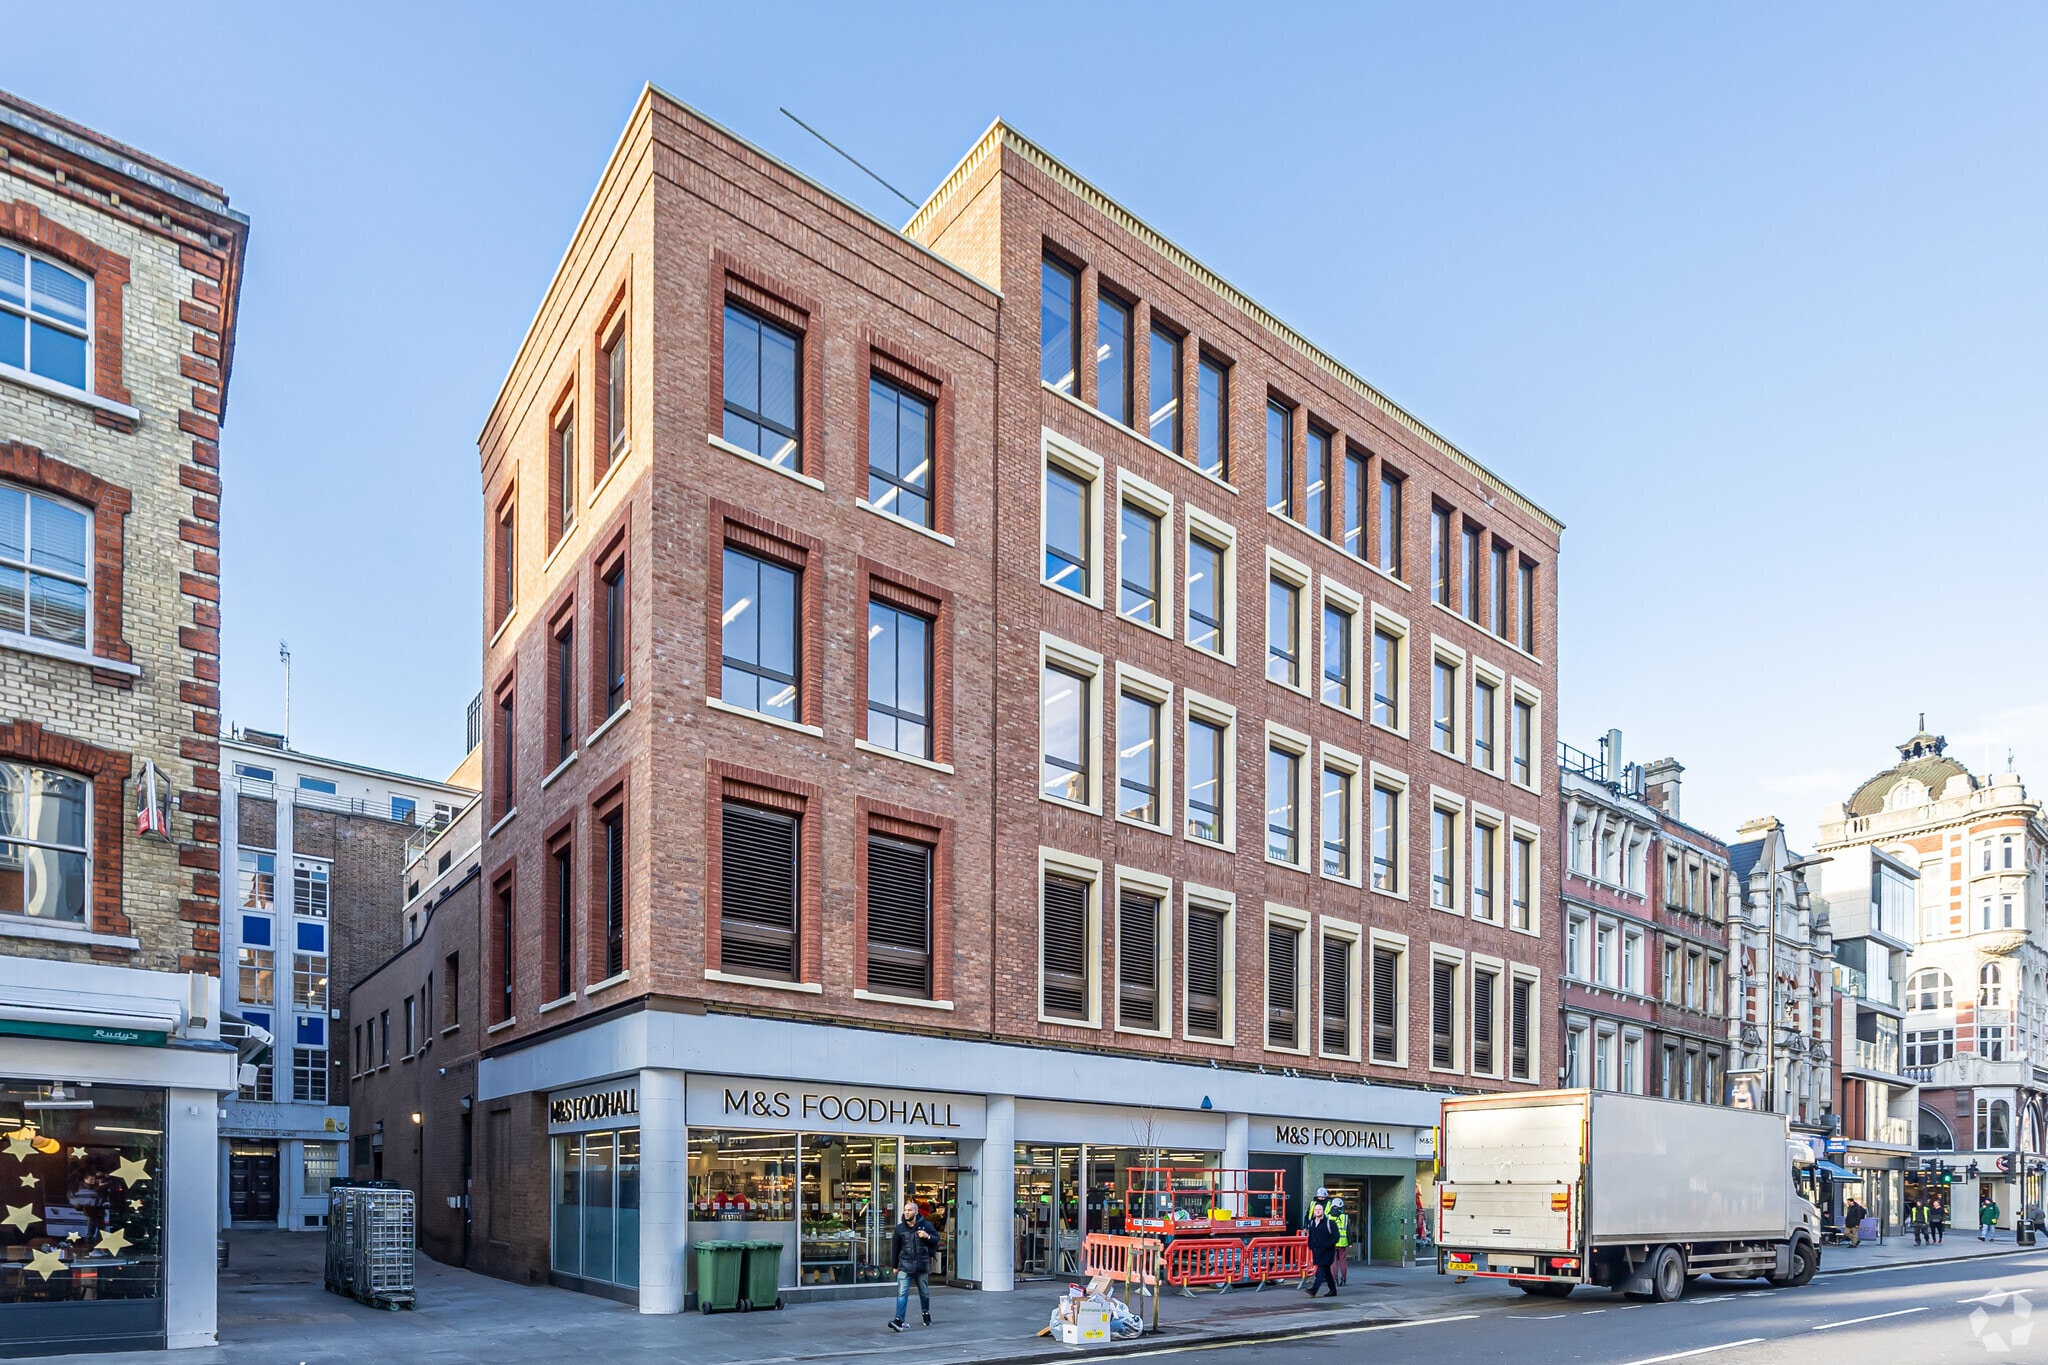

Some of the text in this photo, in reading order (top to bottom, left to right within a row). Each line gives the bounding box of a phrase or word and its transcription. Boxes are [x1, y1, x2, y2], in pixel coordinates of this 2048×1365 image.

[93, 1030, 138, 1040] Rudy's
[550, 1088, 640, 1124] M&S FOODHALL
[723, 1088, 961, 1128] M&S FOODHALL
[229, 1109, 284, 1119] KIRKMAN
[237, 1119, 276, 1128] HOUSE
[1276, 1125, 1395, 1150] M&S FOODHALL
[1419, 1137, 1434, 1145] M&S
